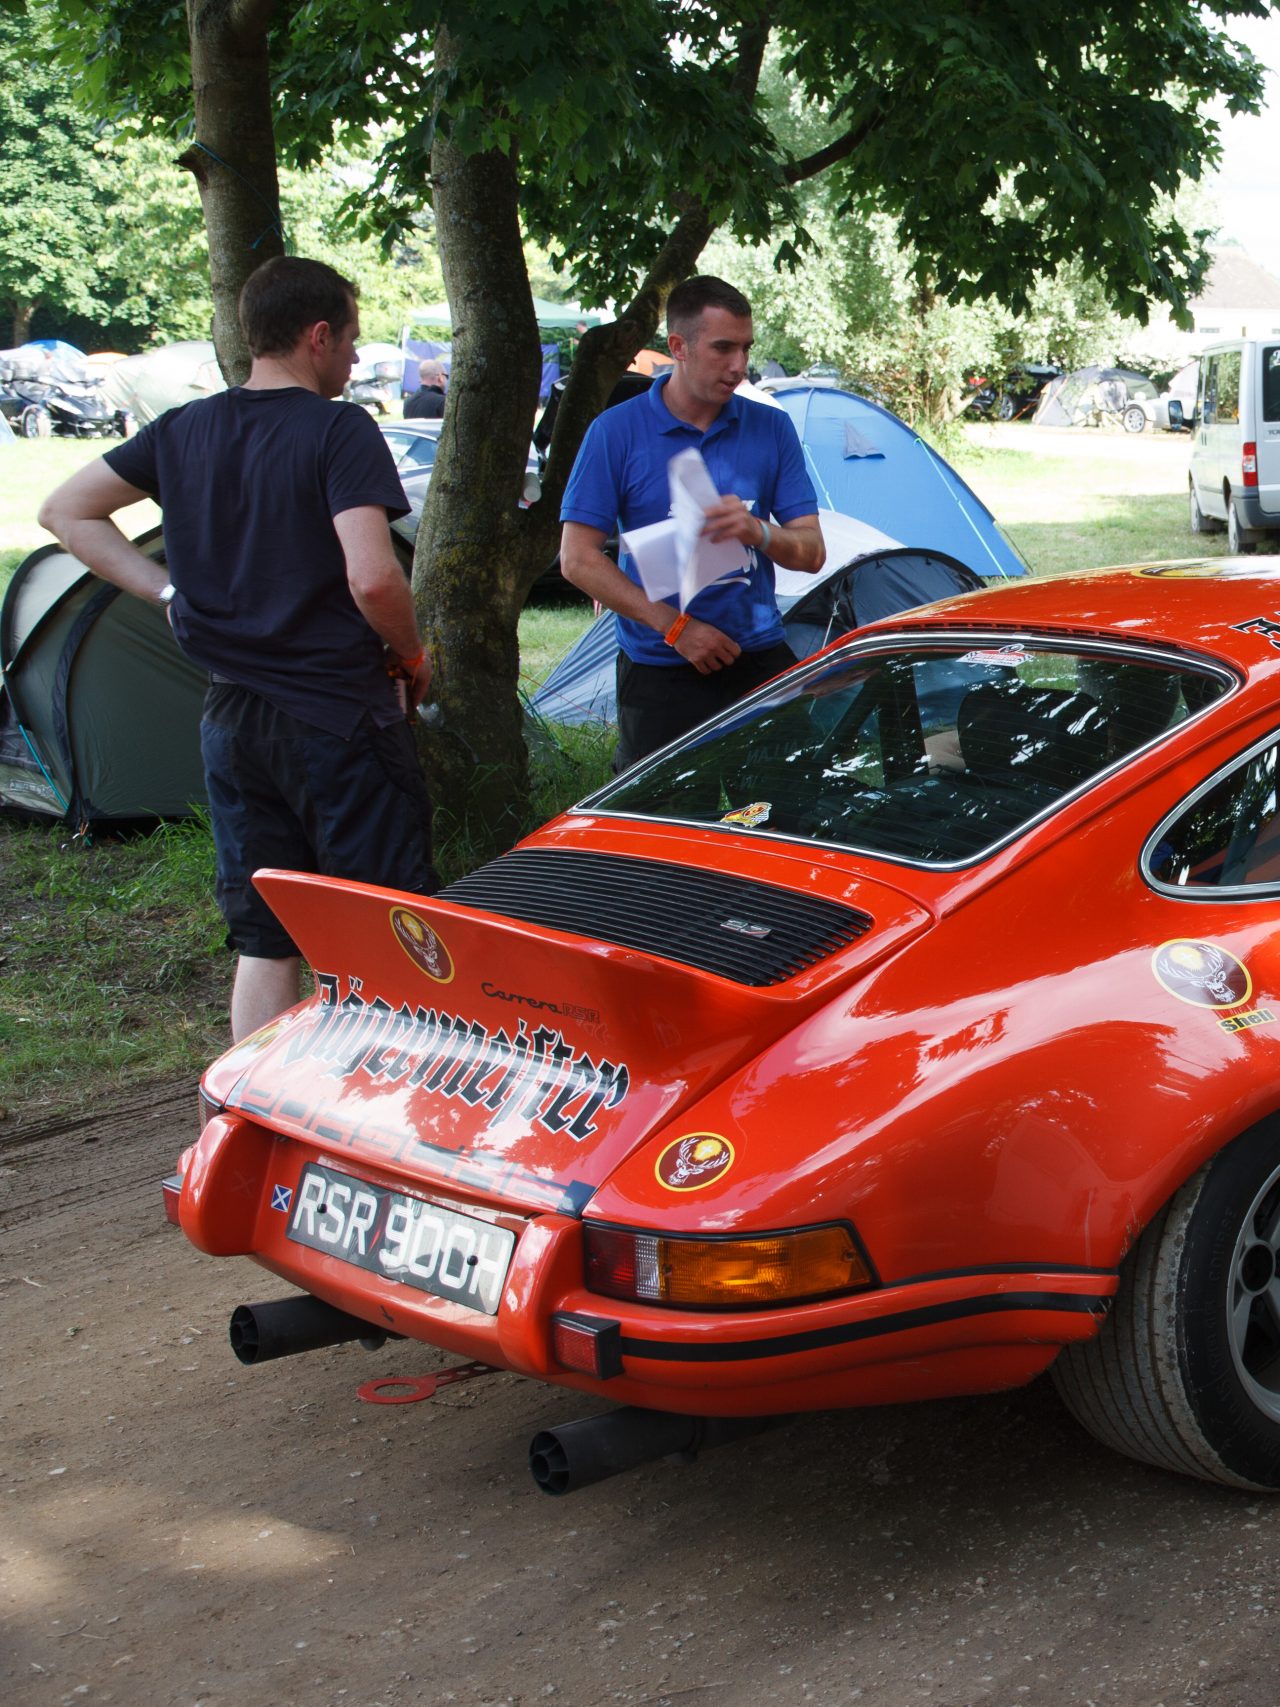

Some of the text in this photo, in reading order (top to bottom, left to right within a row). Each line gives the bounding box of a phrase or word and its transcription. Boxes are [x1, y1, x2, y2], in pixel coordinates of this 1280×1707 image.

[480, 981, 562, 1015] Carrera
[1218, 1010, 1275, 1033] Shell
[292, 1173, 517, 1301] RSR 900H
